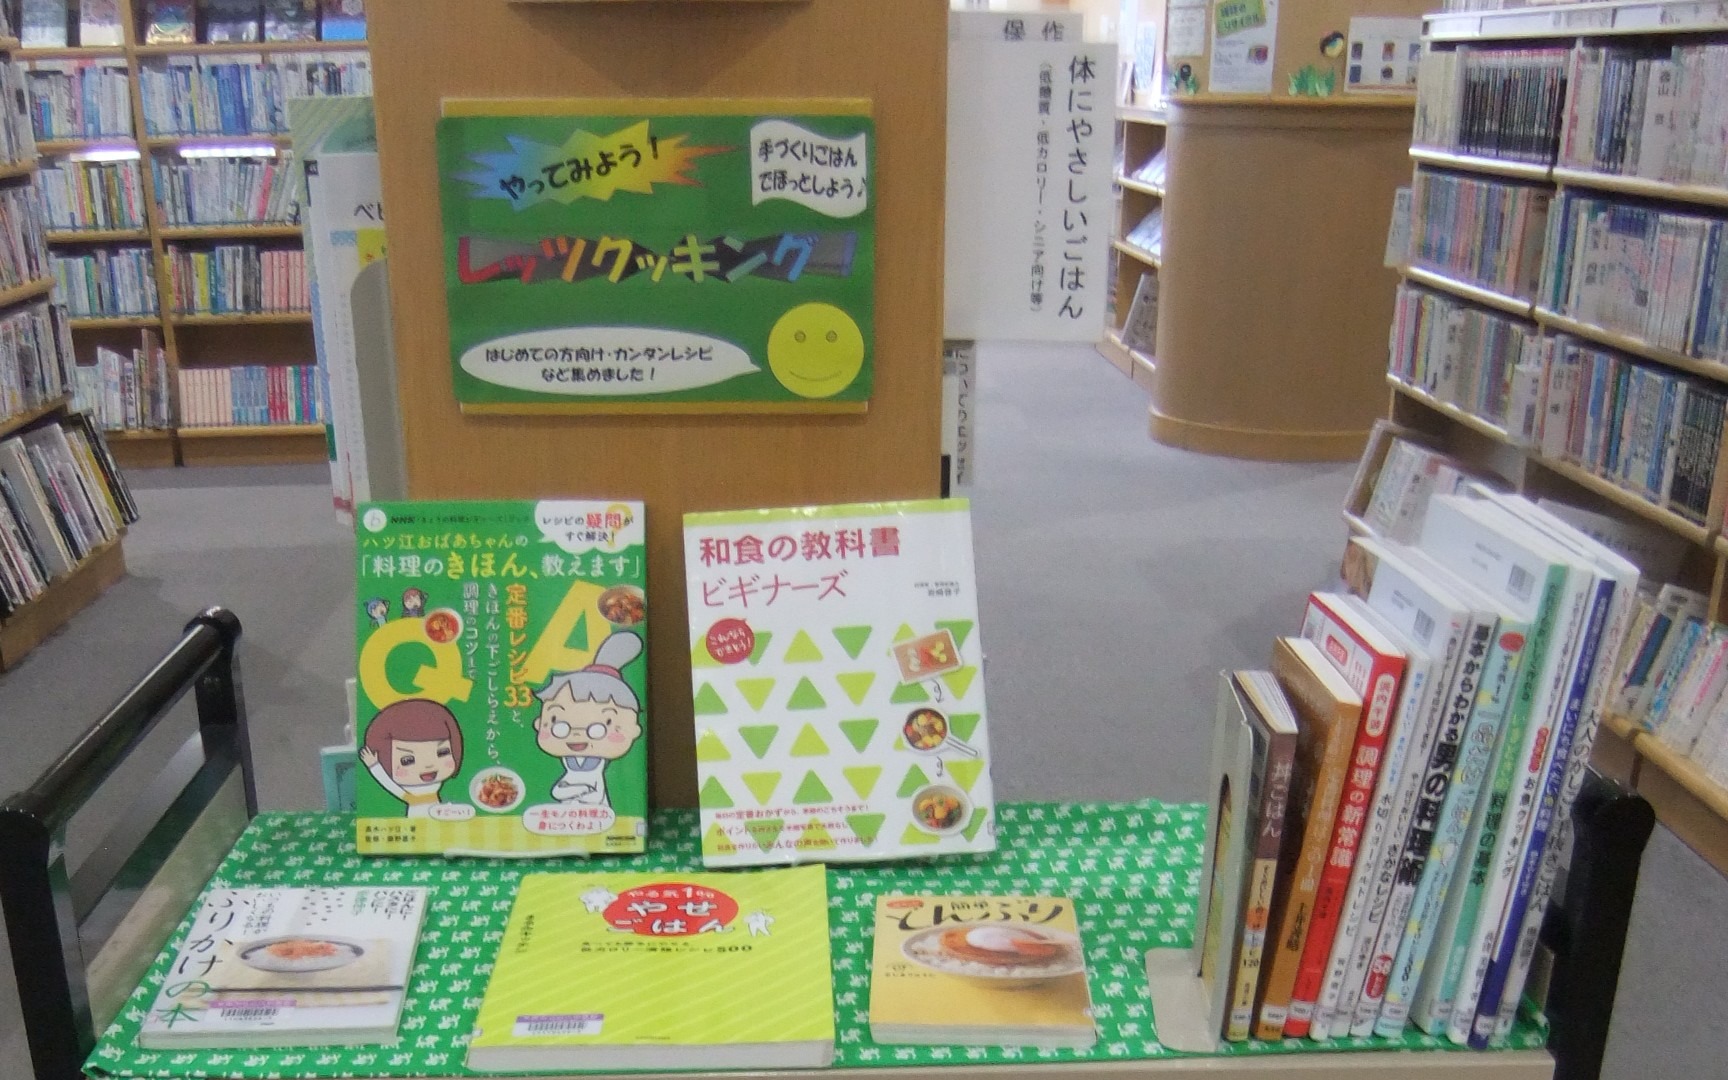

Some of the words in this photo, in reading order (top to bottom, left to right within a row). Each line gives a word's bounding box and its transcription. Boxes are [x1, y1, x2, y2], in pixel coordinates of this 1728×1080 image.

[758, 138, 859, 168] 手づくりごはん
[1058, 55, 1096, 319] 体にやさしいごはん
[542, 511, 634, 530] レシピの疑問が
[700, 526, 900, 568] 和食の教科書
[702, 568, 848, 608] ビギナーズ
[626, 901, 718, 917] やせ
[606, 918, 736, 935] ごはん
